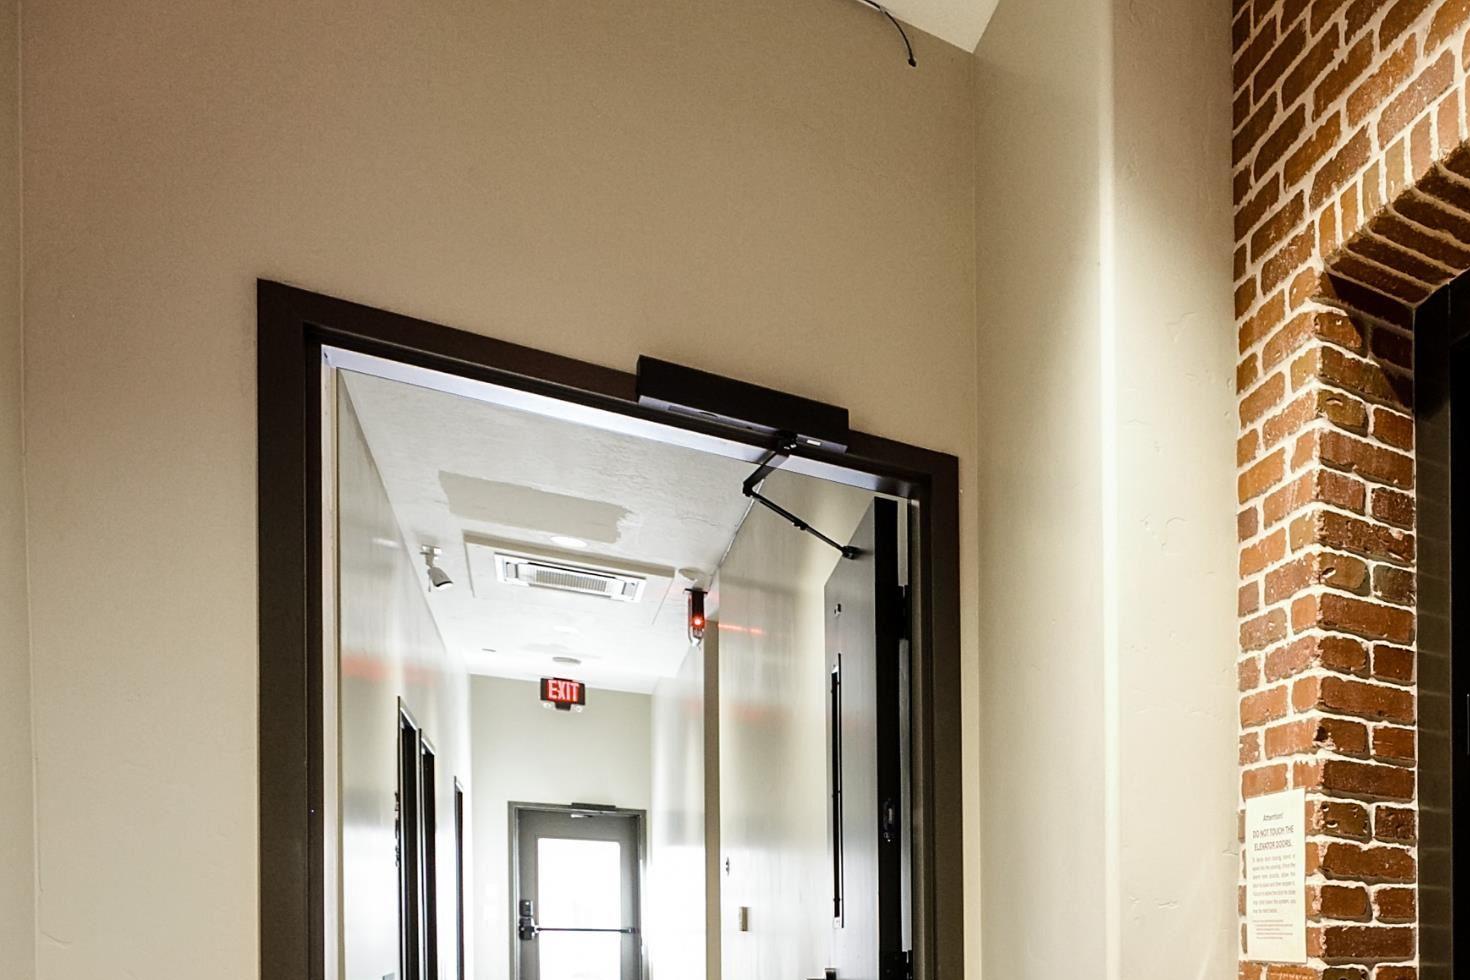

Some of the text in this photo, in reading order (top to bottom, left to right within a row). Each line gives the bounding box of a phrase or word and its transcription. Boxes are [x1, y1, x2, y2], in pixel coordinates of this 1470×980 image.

[547, 680, 580, 702] EXIT
[1252, 824, 1294, 839] DO NOT TOUCH THE
[1254, 841, 1275, 851] ELEVATOR
